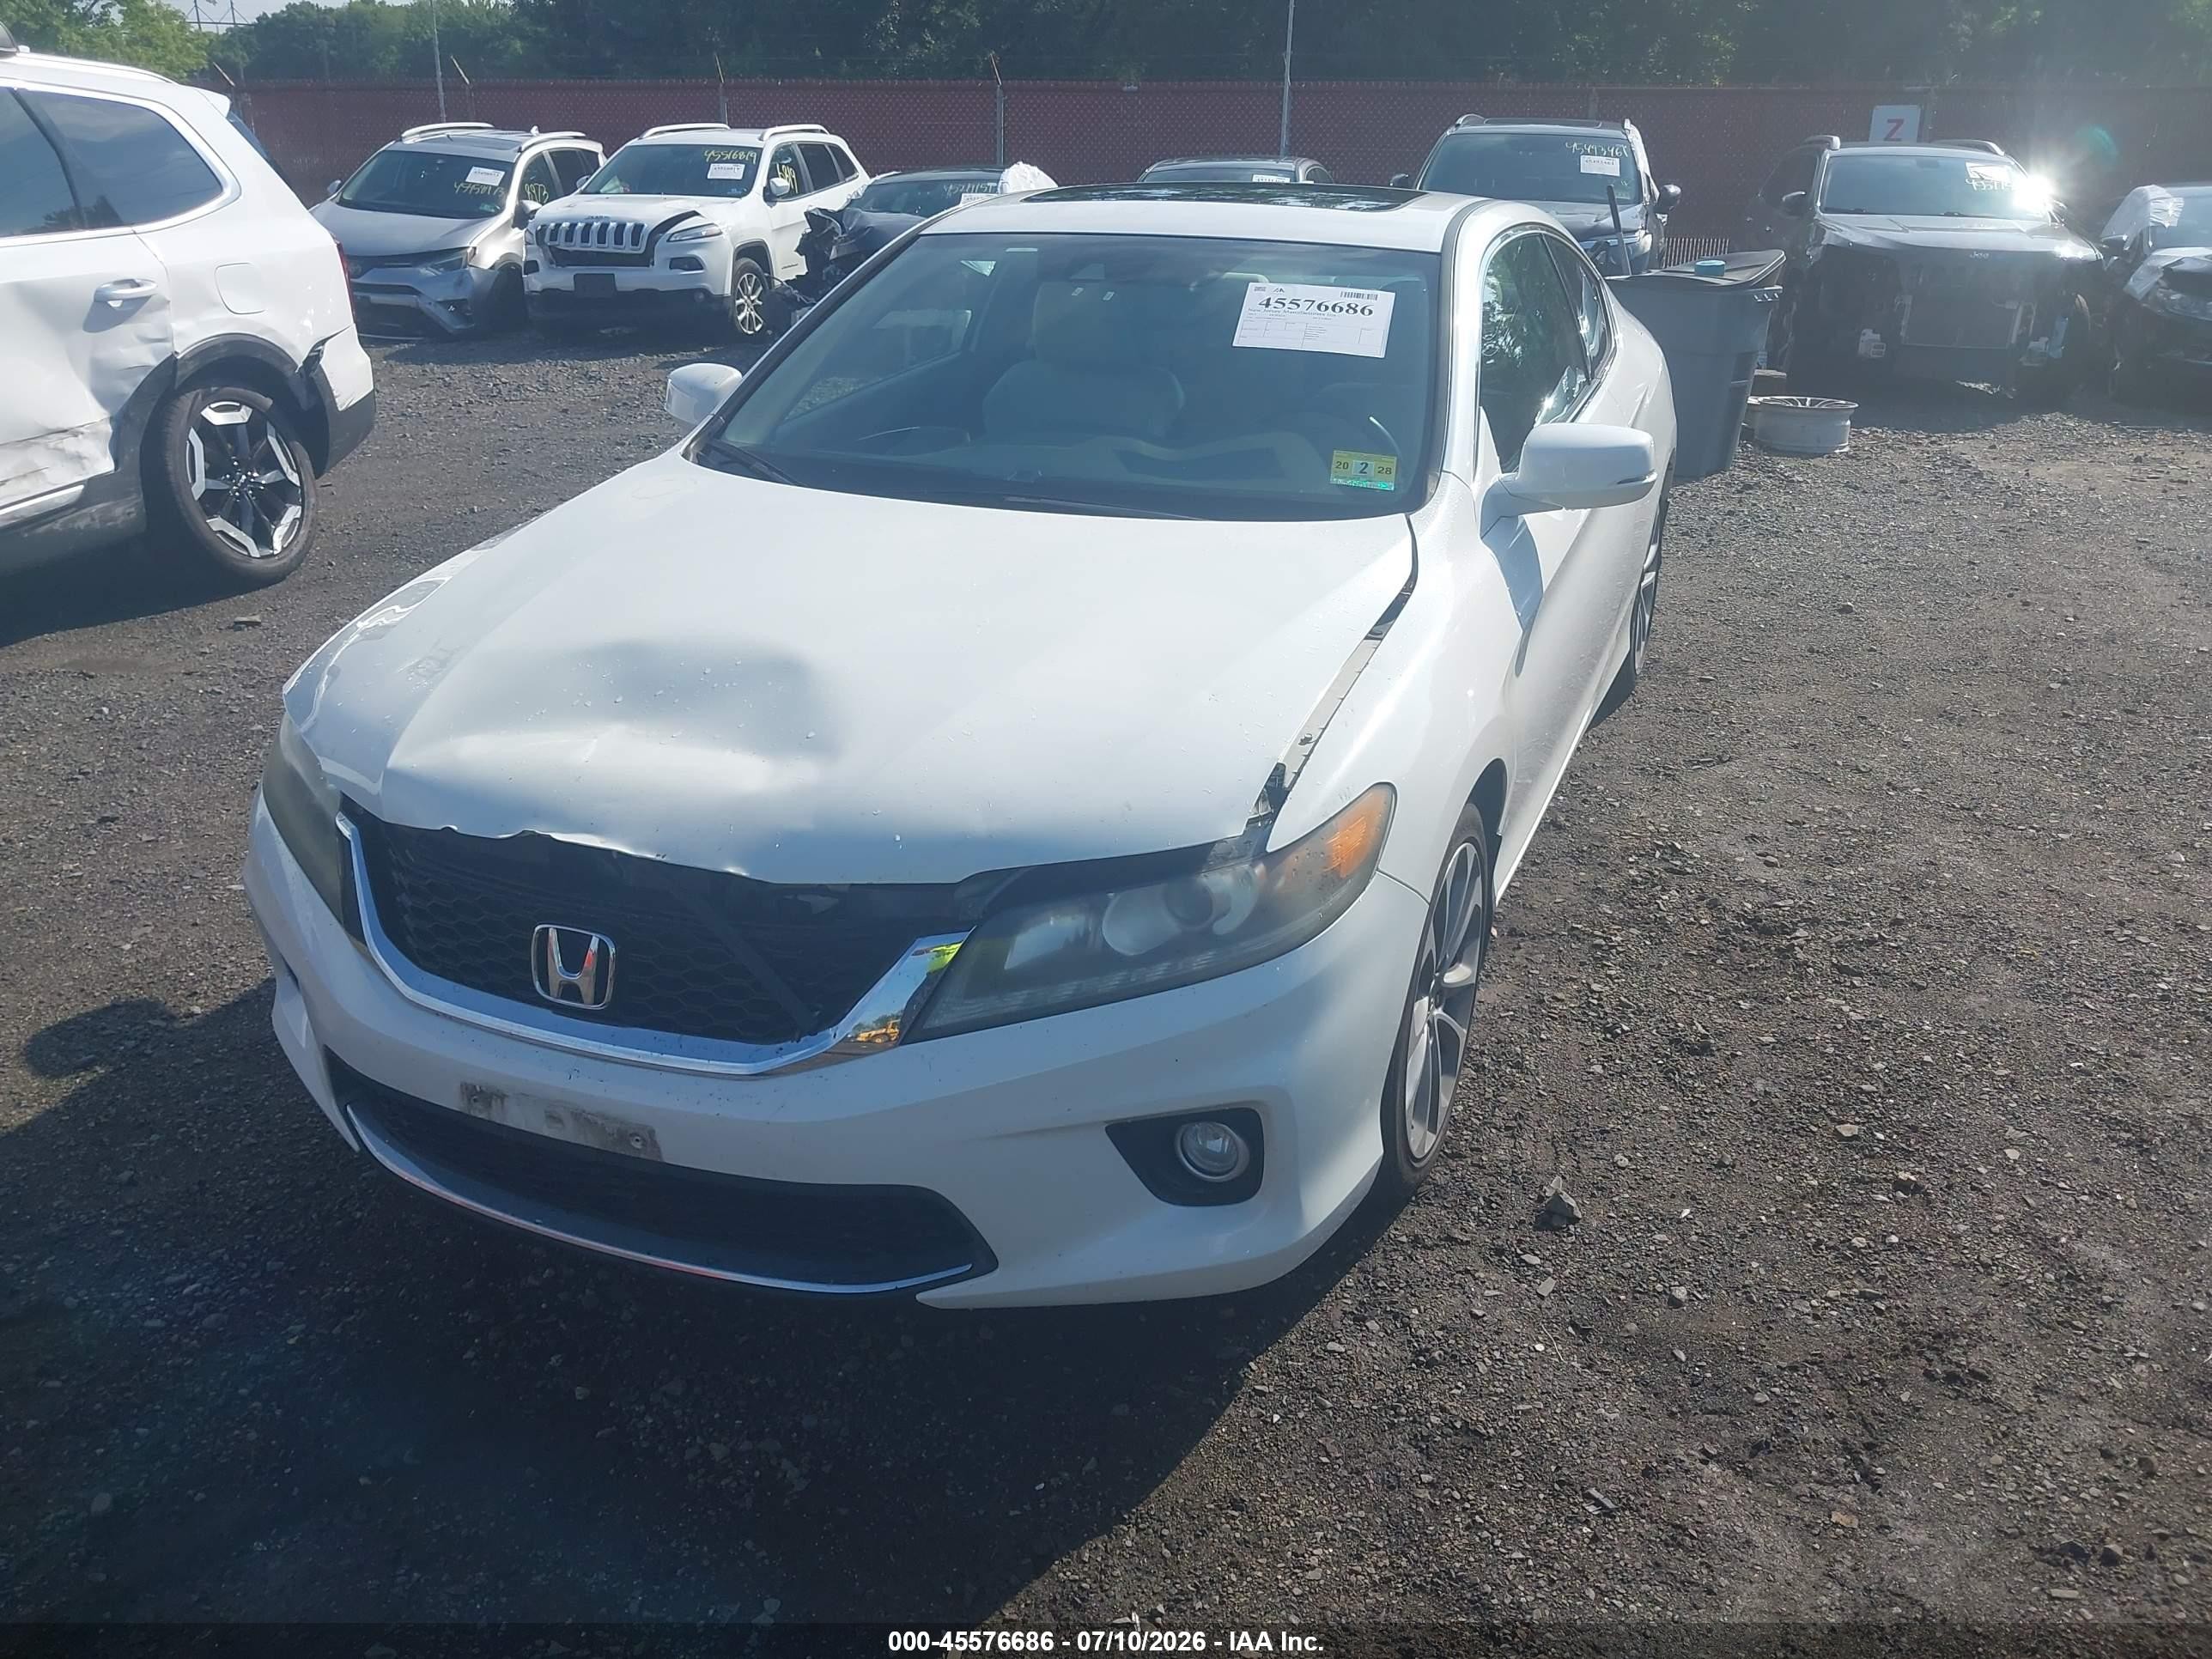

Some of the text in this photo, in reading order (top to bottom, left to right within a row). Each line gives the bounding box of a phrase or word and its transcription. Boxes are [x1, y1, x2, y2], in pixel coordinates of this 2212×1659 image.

[1883, 118, 1905, 142] Z
[704, 150, 757, 165] 45516819
[1258, 296, 1374, 317] 45576686
[1335, 460, 1392, 475] 20 2 28
